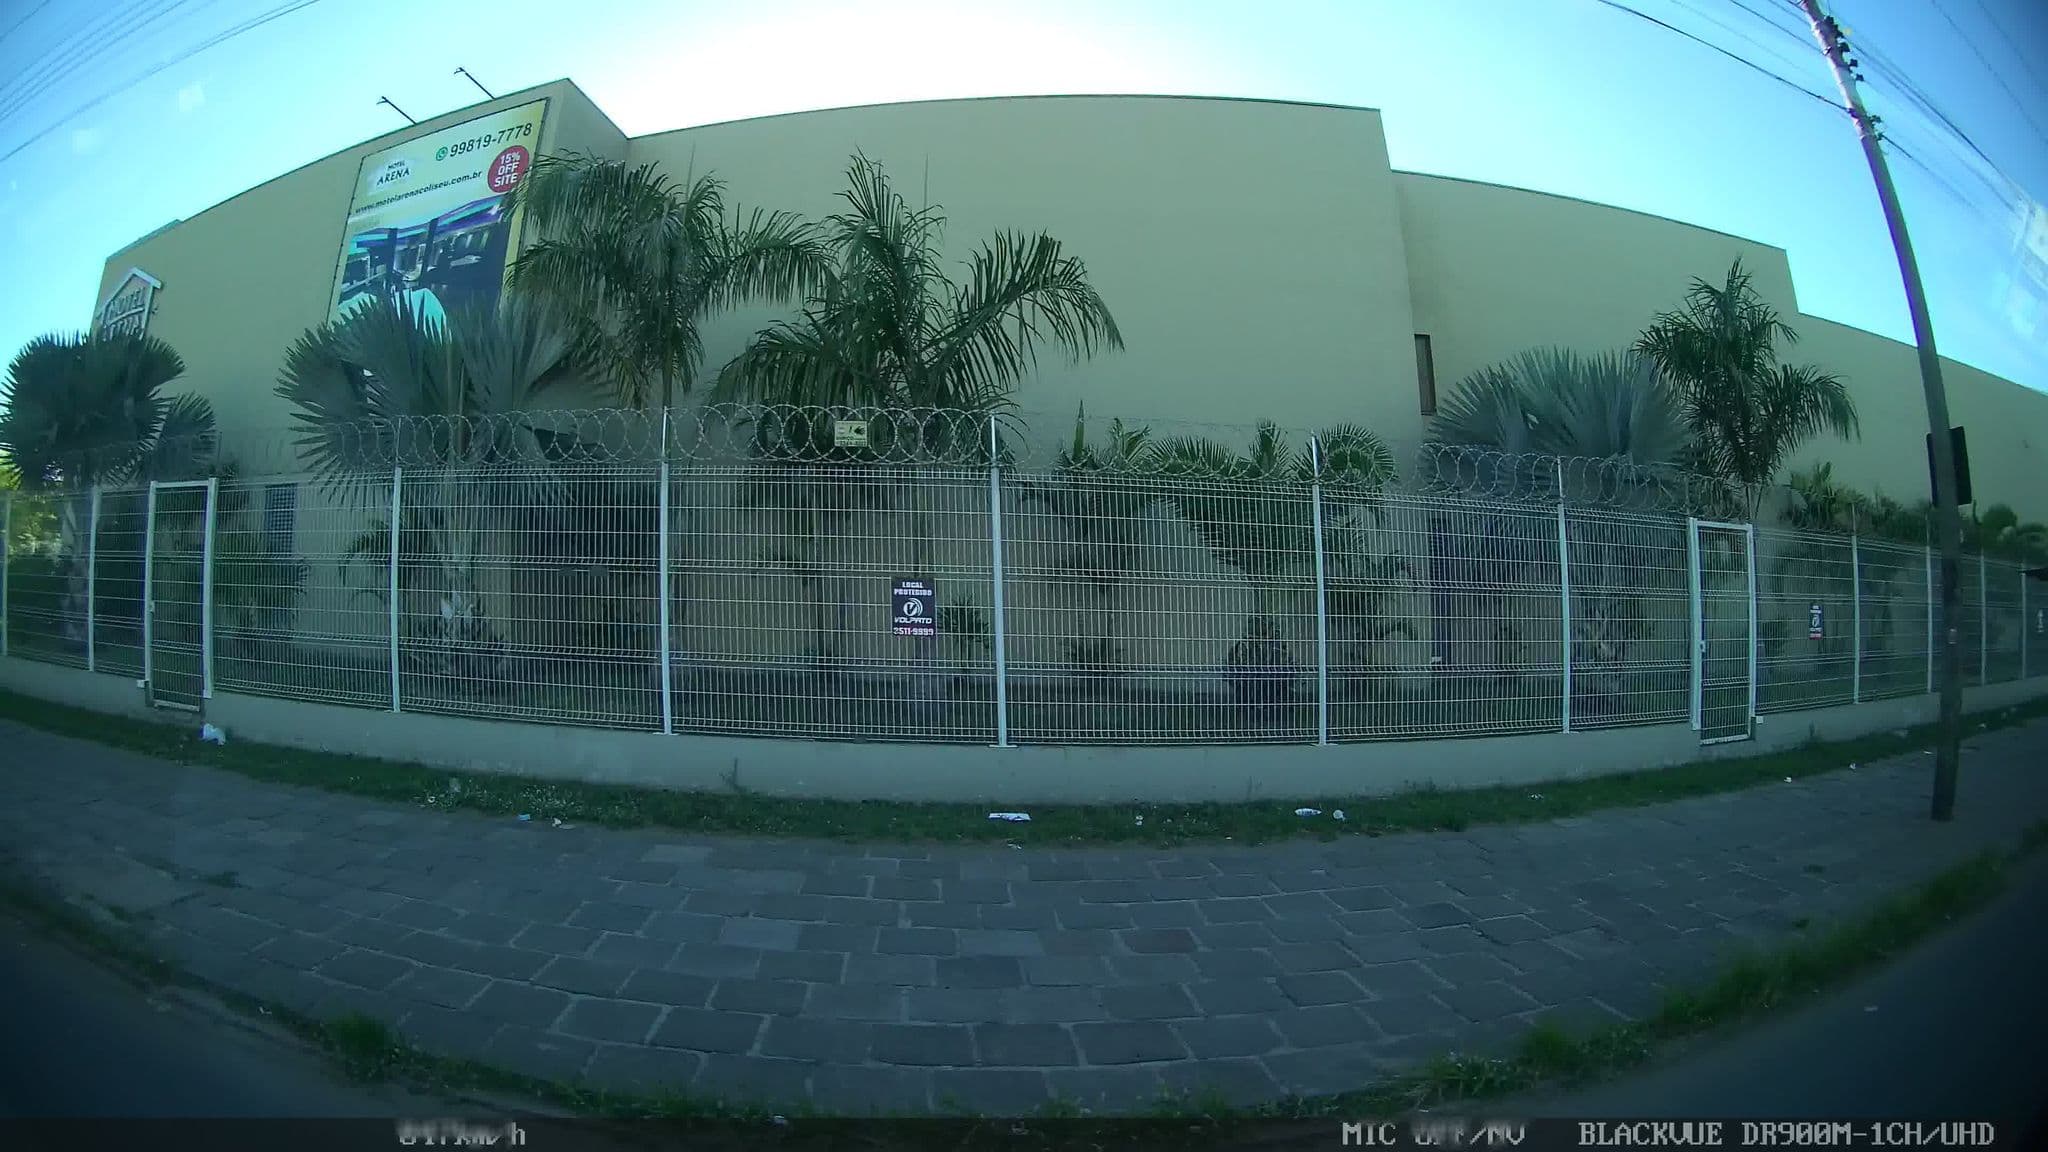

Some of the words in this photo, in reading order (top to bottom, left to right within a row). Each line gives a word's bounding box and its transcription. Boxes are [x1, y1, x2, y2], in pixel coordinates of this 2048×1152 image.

[449, 122, 533, 158] 99819-7778
[500, 152, 521, 165] 15%
[498, 162, 520, 175] OFF
[376, 167, 410, 186] ARENA
[494, 173, 519, 187] SITE
